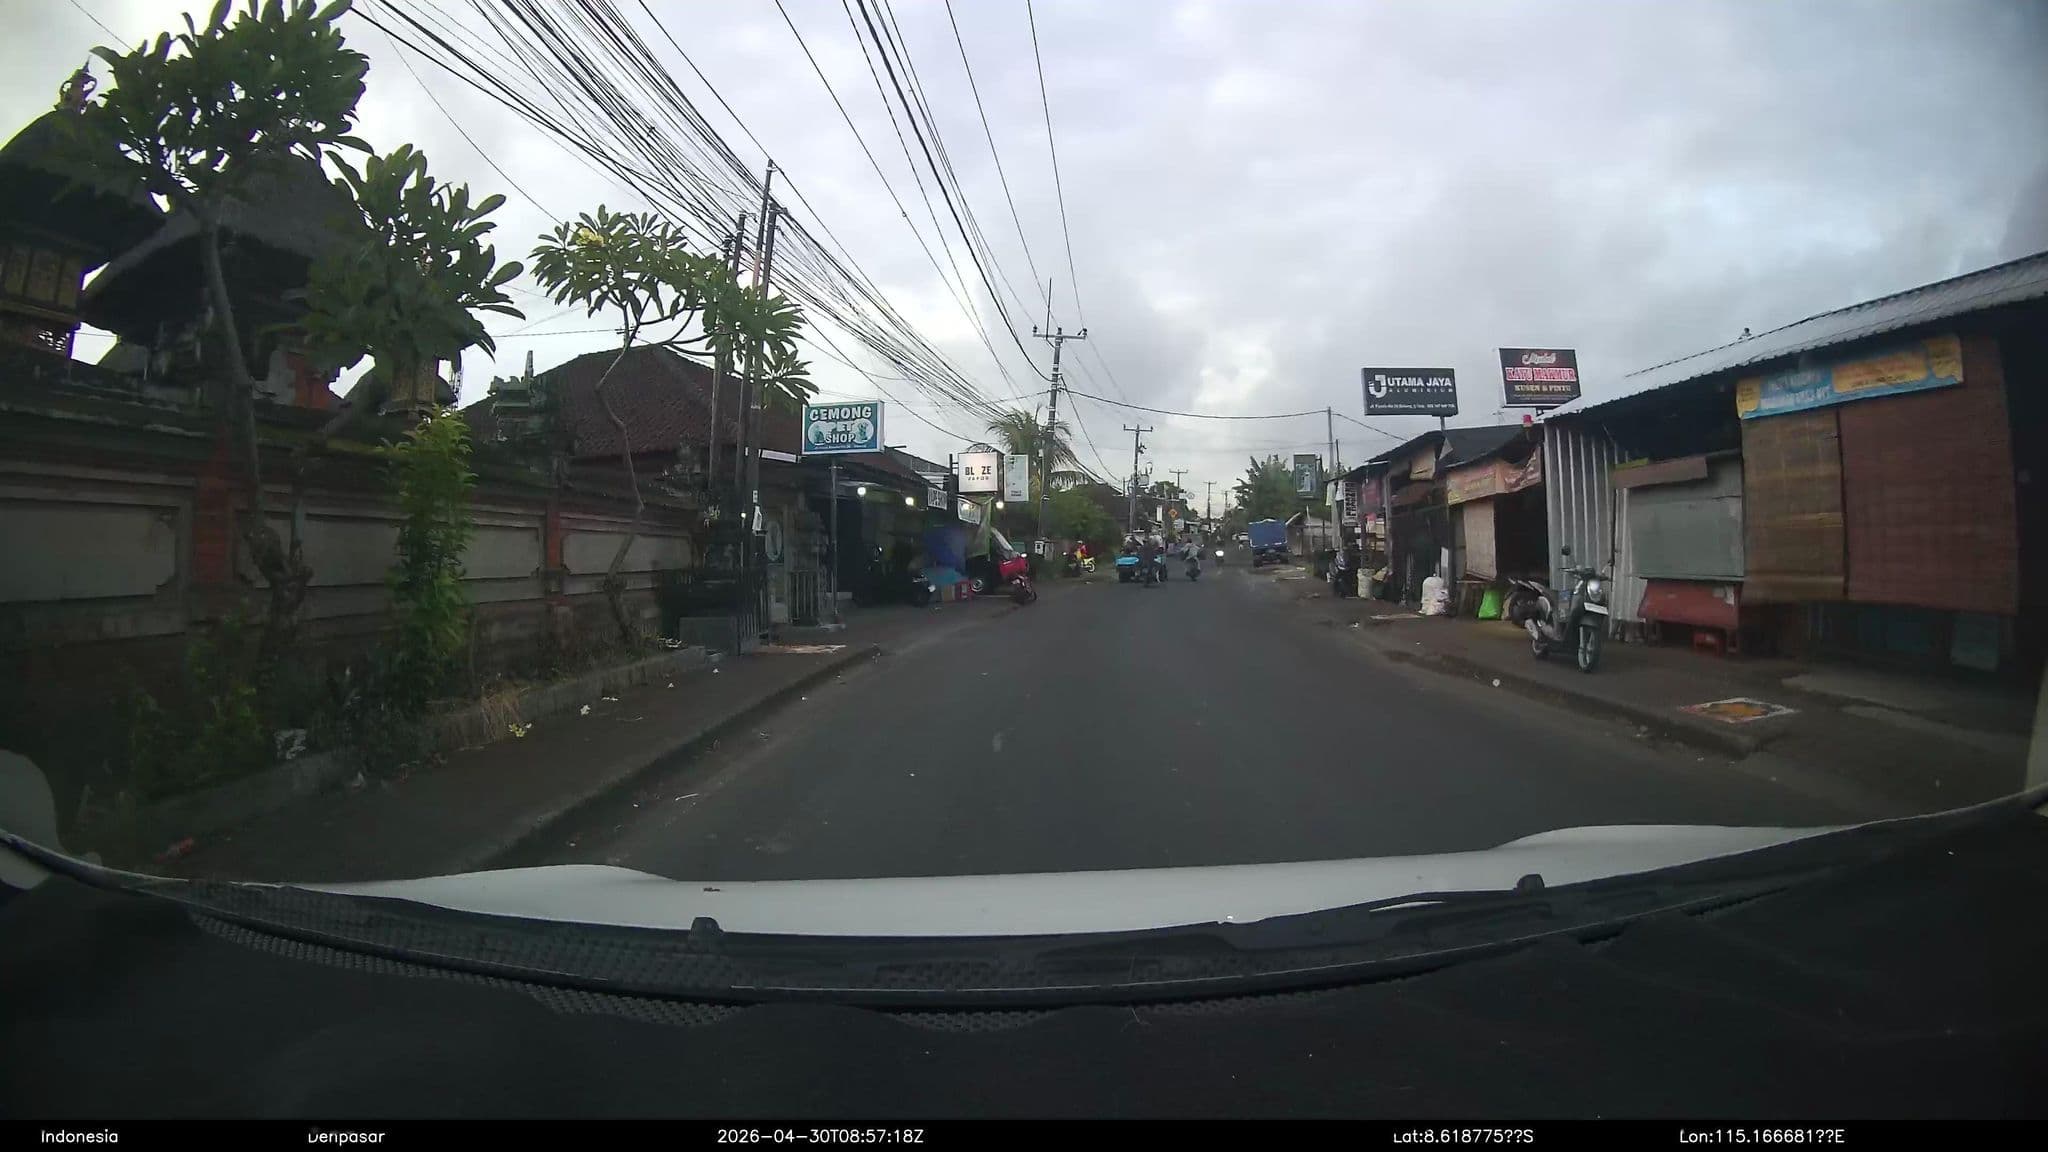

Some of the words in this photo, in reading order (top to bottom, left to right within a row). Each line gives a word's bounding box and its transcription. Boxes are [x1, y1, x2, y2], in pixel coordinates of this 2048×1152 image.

[1387, 377, 1424, 387] UTAMA
[1426, 377, 1452, 387] JAYA
[809, 406, 872, 421] CEMONG
[826, 421, 854, 432] PET
[825, 433, 855, 444] SHOP
[964, 465, 992, 475] BLZE
